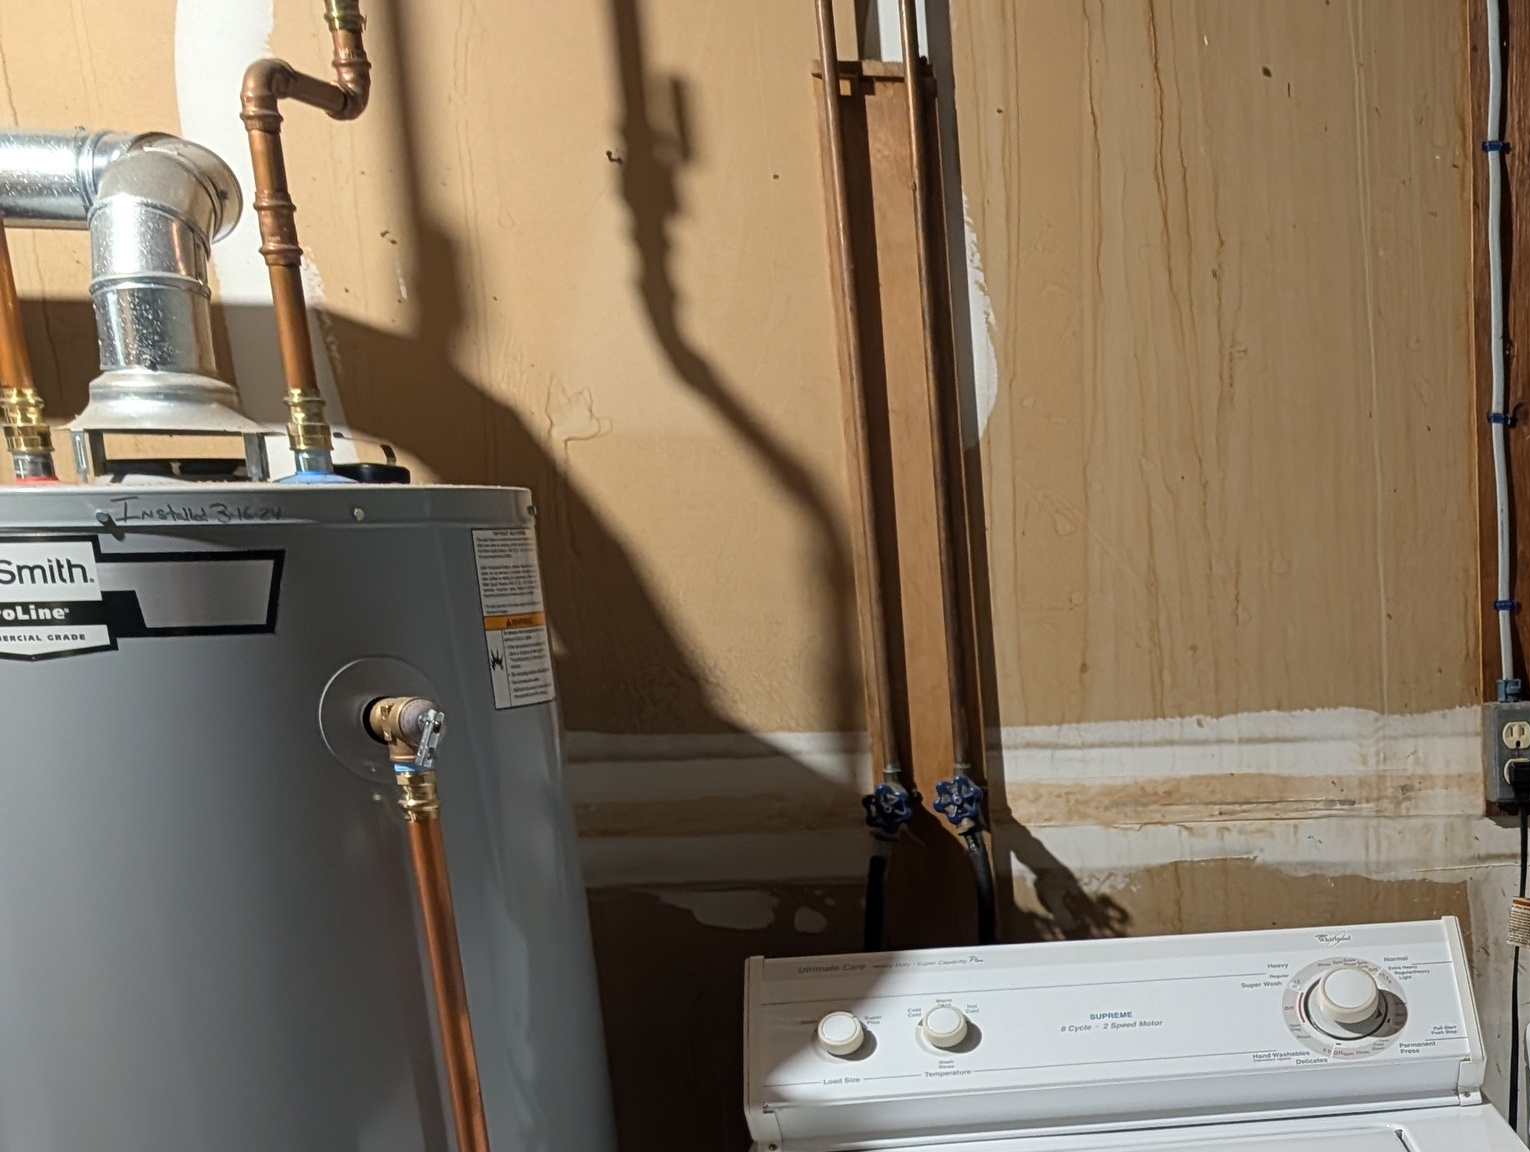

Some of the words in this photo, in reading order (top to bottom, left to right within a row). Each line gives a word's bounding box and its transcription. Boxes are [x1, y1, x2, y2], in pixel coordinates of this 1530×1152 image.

[0, 604, 66, 621] oLine
[0, 634, 42, 642] ERCIAL
[47, 634, 86, 642] GRADE
[1090, 1011, 1132, 1020] SUPREME
[1068, 1024, 1092, 1033] Cycle
[1111, 1021, 1137, 1030] Speed
[925, 1068, 972, 1078] Temperature
[823, 1077, 842, 1085] Load
